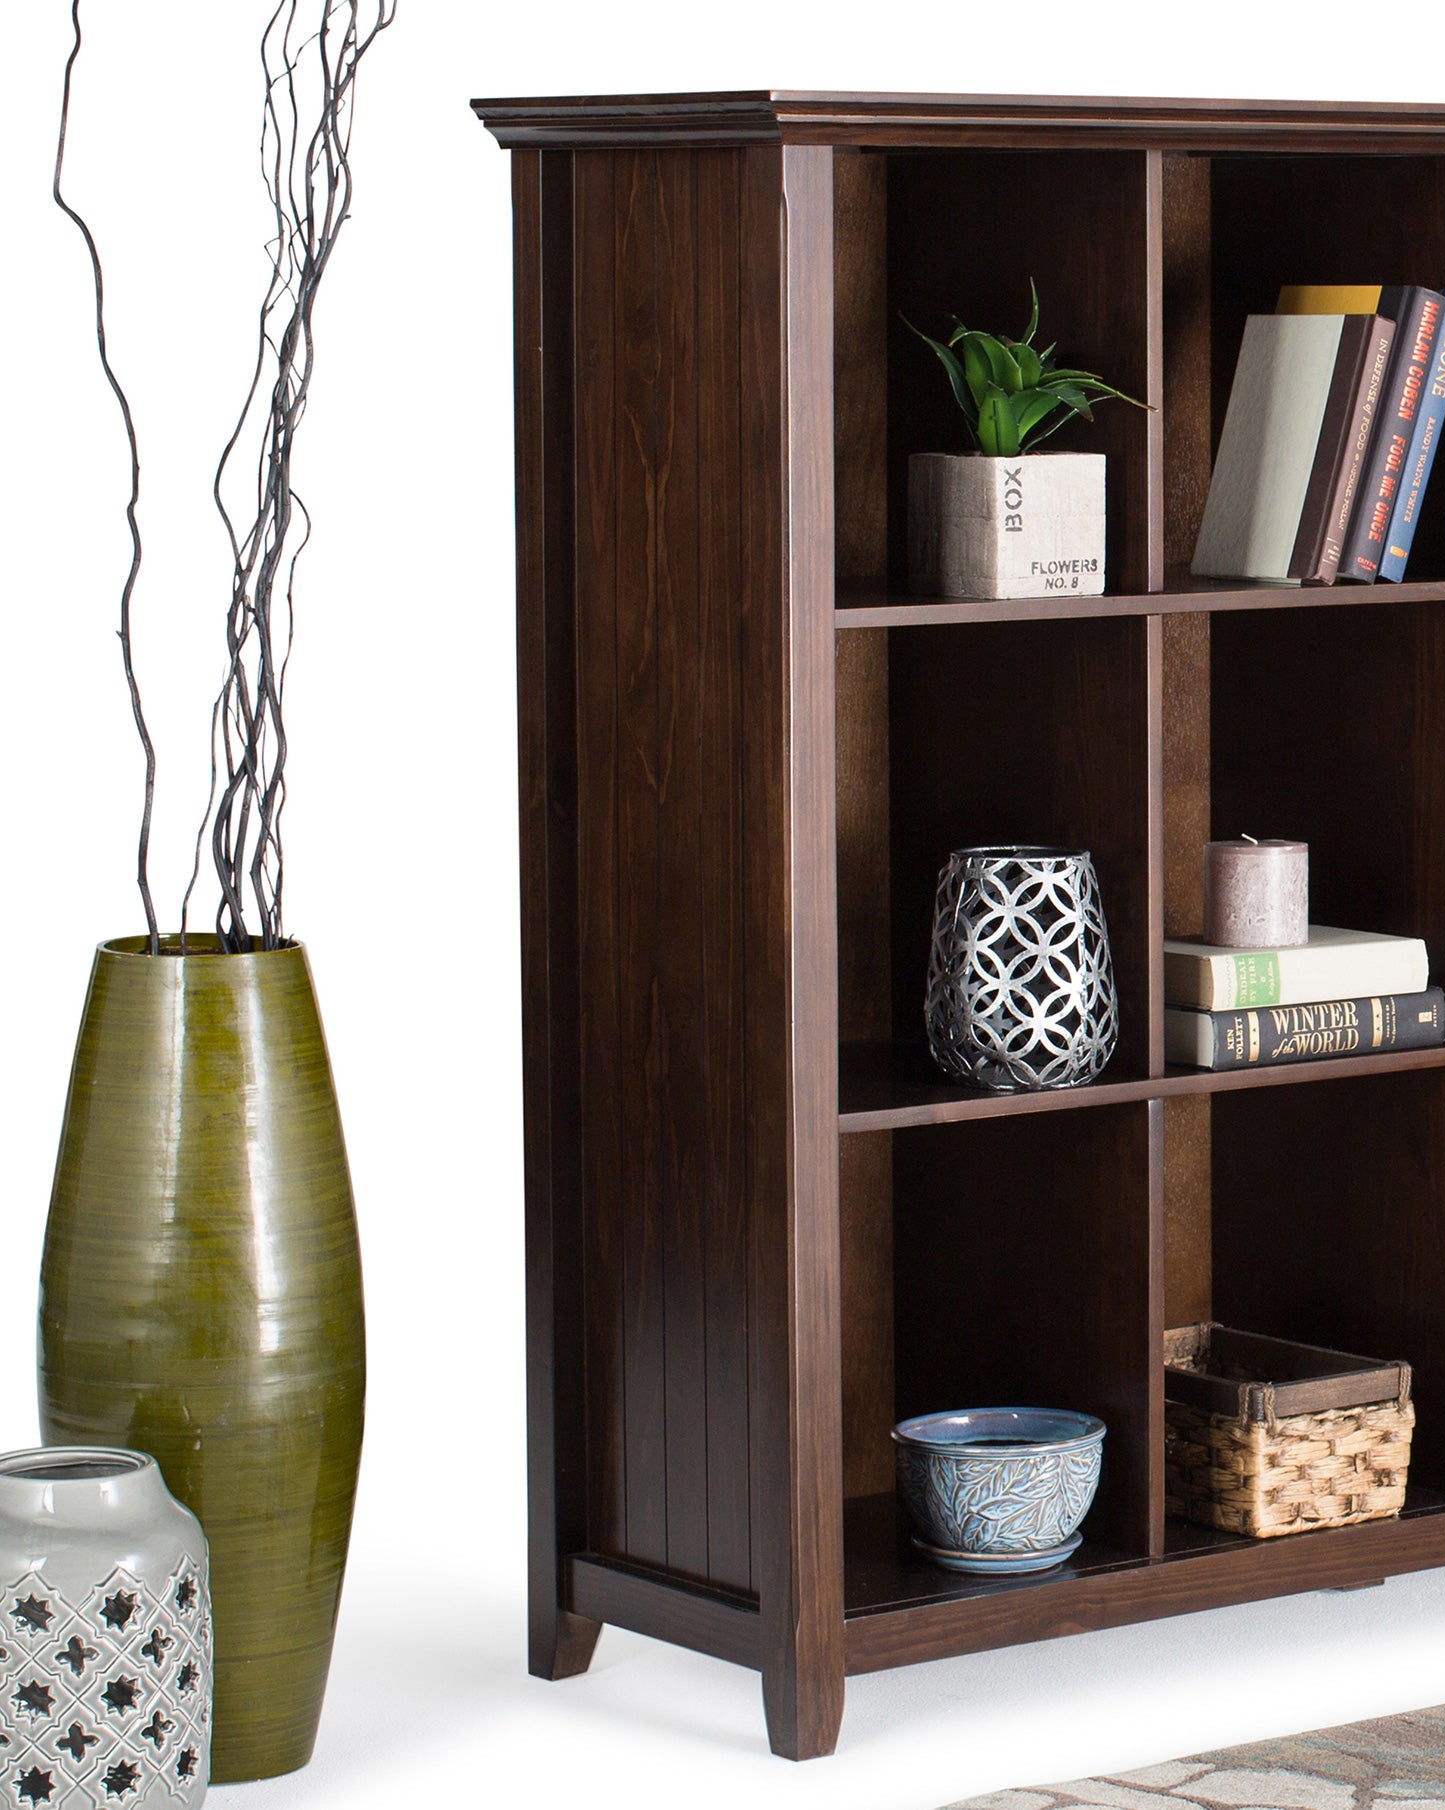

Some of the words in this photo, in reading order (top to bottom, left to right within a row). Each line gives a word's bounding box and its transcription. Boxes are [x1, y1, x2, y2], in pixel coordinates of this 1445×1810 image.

[1379, 338, 1389, 353] IN
[1411, 299, 1440, 364] HARLAN
[1367, 354, 1385, 403] DEFENSE
[1397, 364, 1424, 421] COBEN
[1363, 403, 1372, 416] of
[1356, 416, 1371, 450] FOOD
[1421, 416, 1436, 453] RANDY
[1384, 433, 1407, 472] FOOL
[1378, 475, 1396, 500] ME
[1412, 454, 1427, 488] WAYNE
[1004, 466, 1023, 533] BOX
[1403, 490, 1418, 523] WHITE
[1367, 501, 1390, 543] ONCE
[1031, 558, 1098, 575] FLOWERS
[1044, 577, 1068, 590] NO.
[1071, 576, 1079, 589] 8
[1238, 957, 1248, 1004] ORDEAL
[1269, 1001, 1359, 1035] WINTER
[1226, 1028, 1235, 1051] KEN
[1234, 1016, 1244, 1060] FOLLETT
[1271, 1038, 1288, 1058] of
[1293, 1028, 1359, 1056] WORLD
